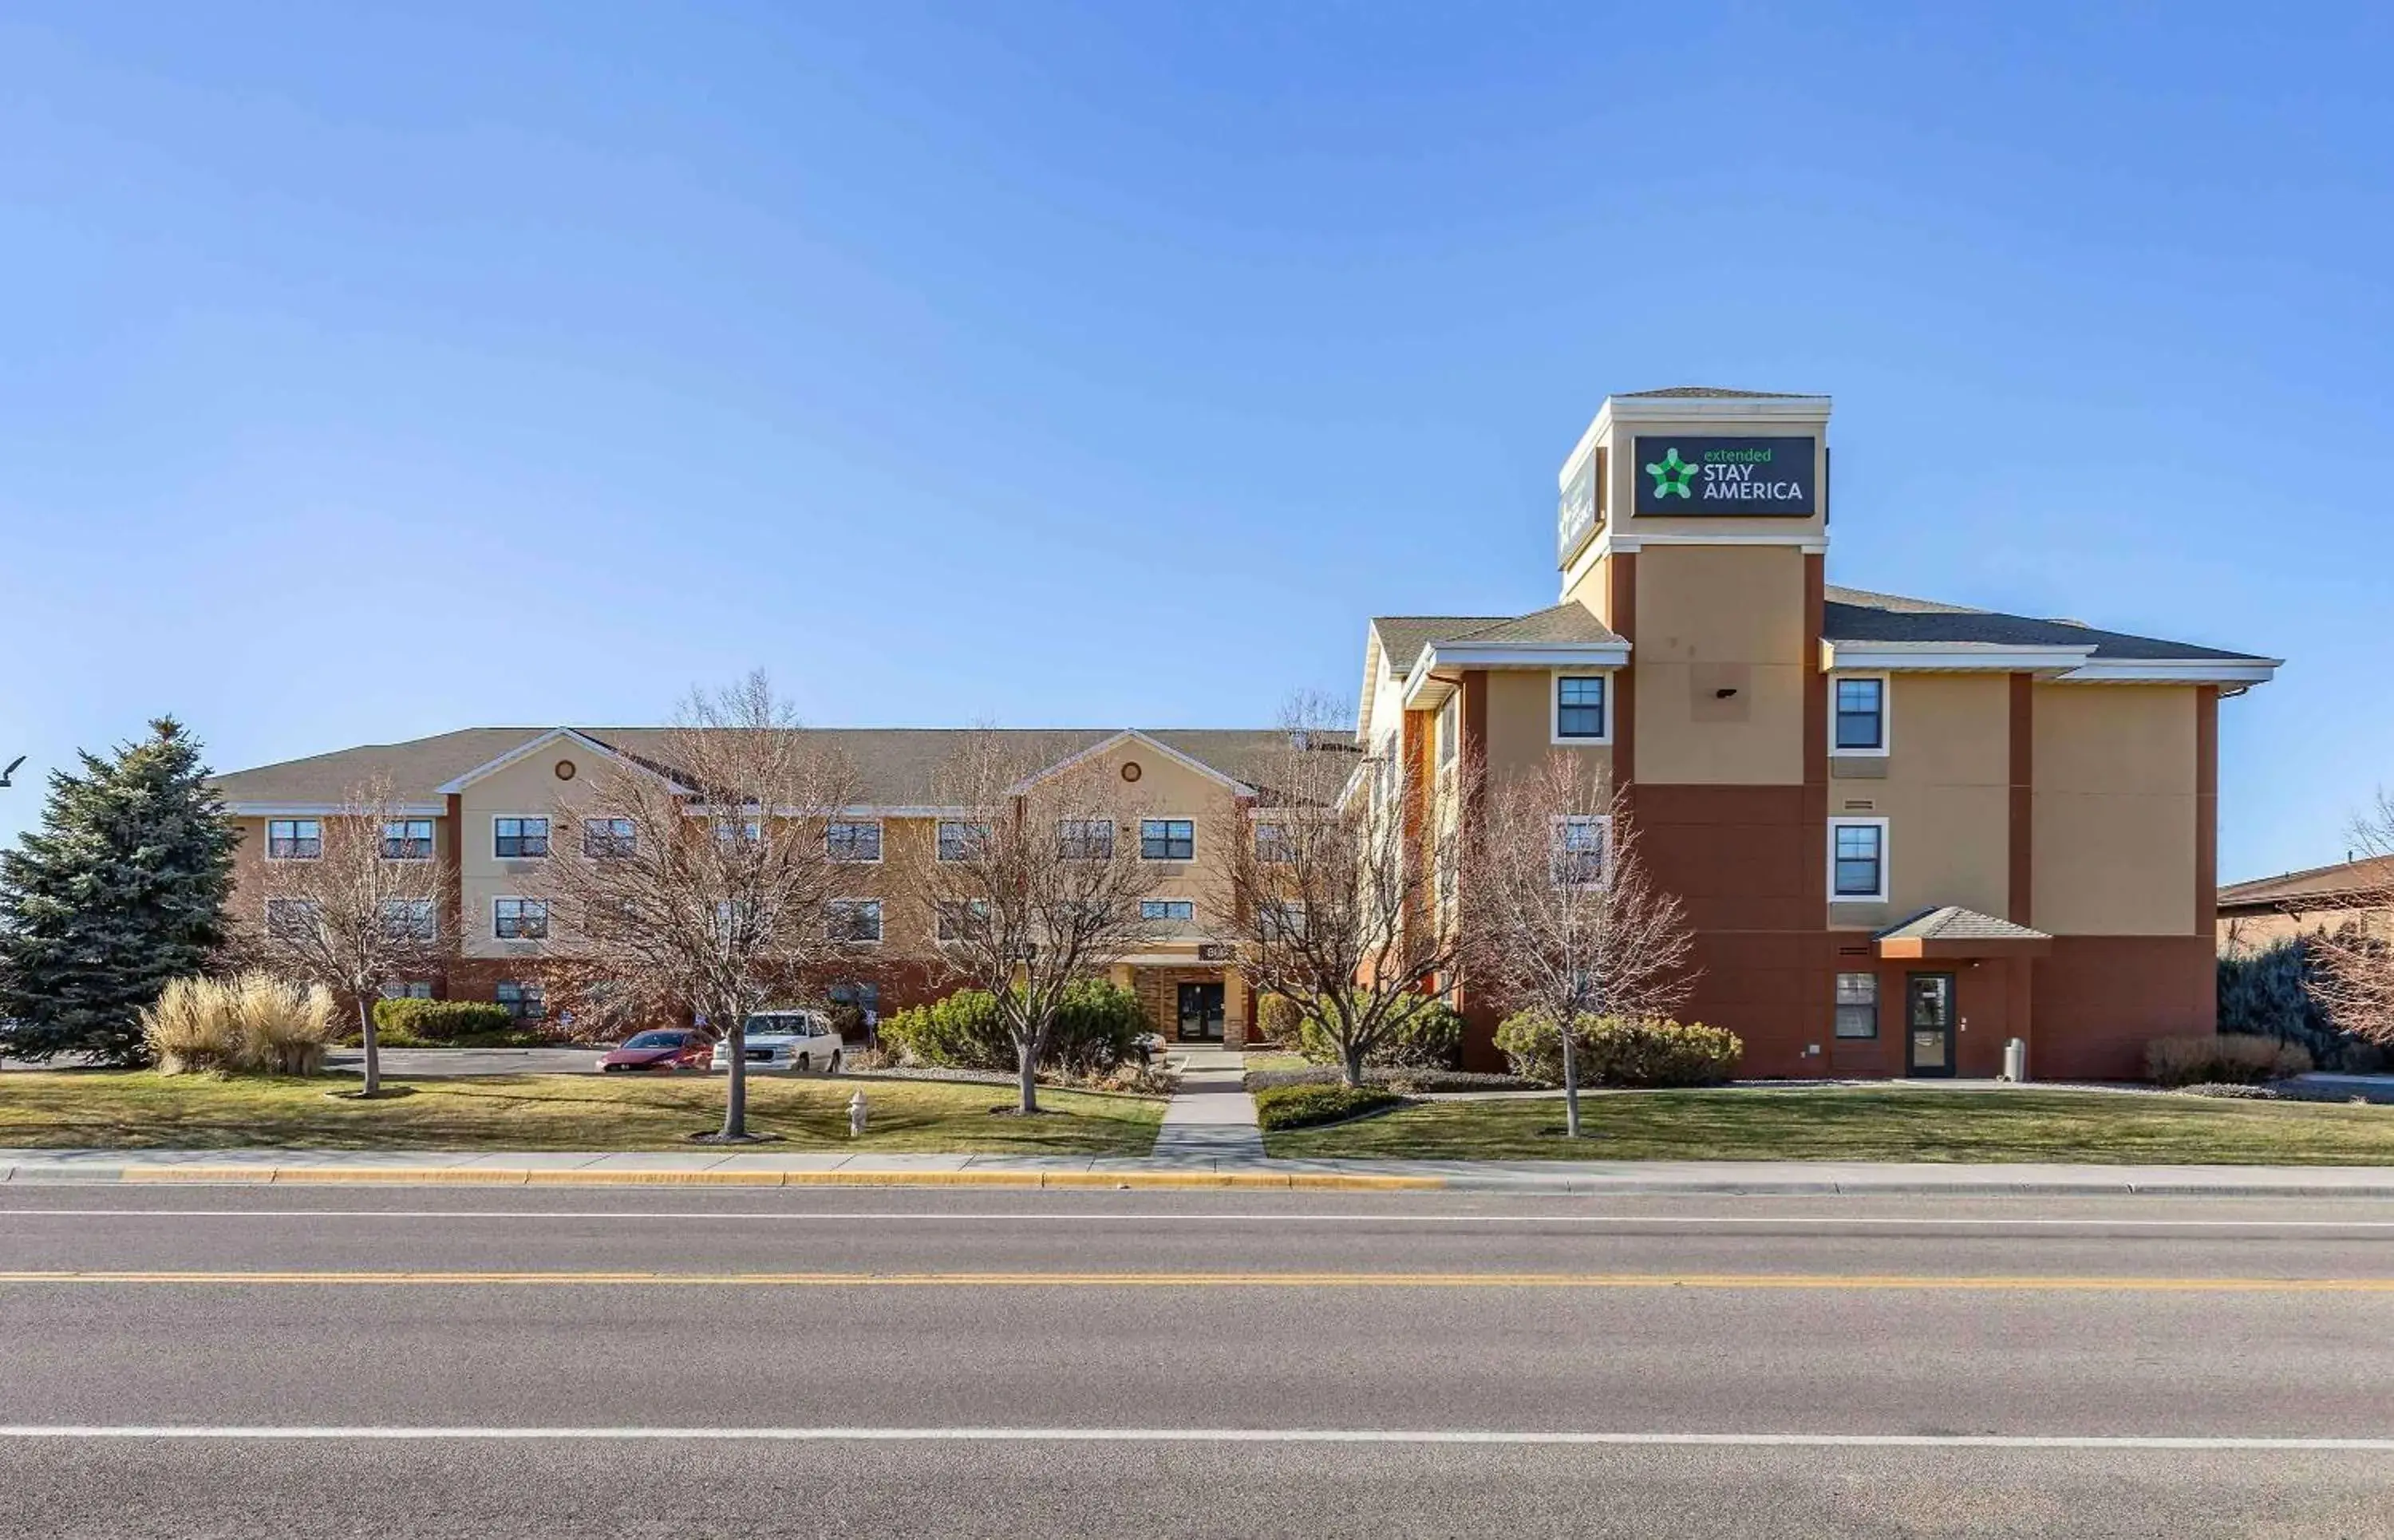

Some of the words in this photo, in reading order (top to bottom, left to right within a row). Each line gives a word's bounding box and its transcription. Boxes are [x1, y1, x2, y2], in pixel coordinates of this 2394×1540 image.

[1705, 448, 1772, 462] extended
[1704, 464, 1755, 481] STAY
[1703, 482, 1803, 500] AMERICA
